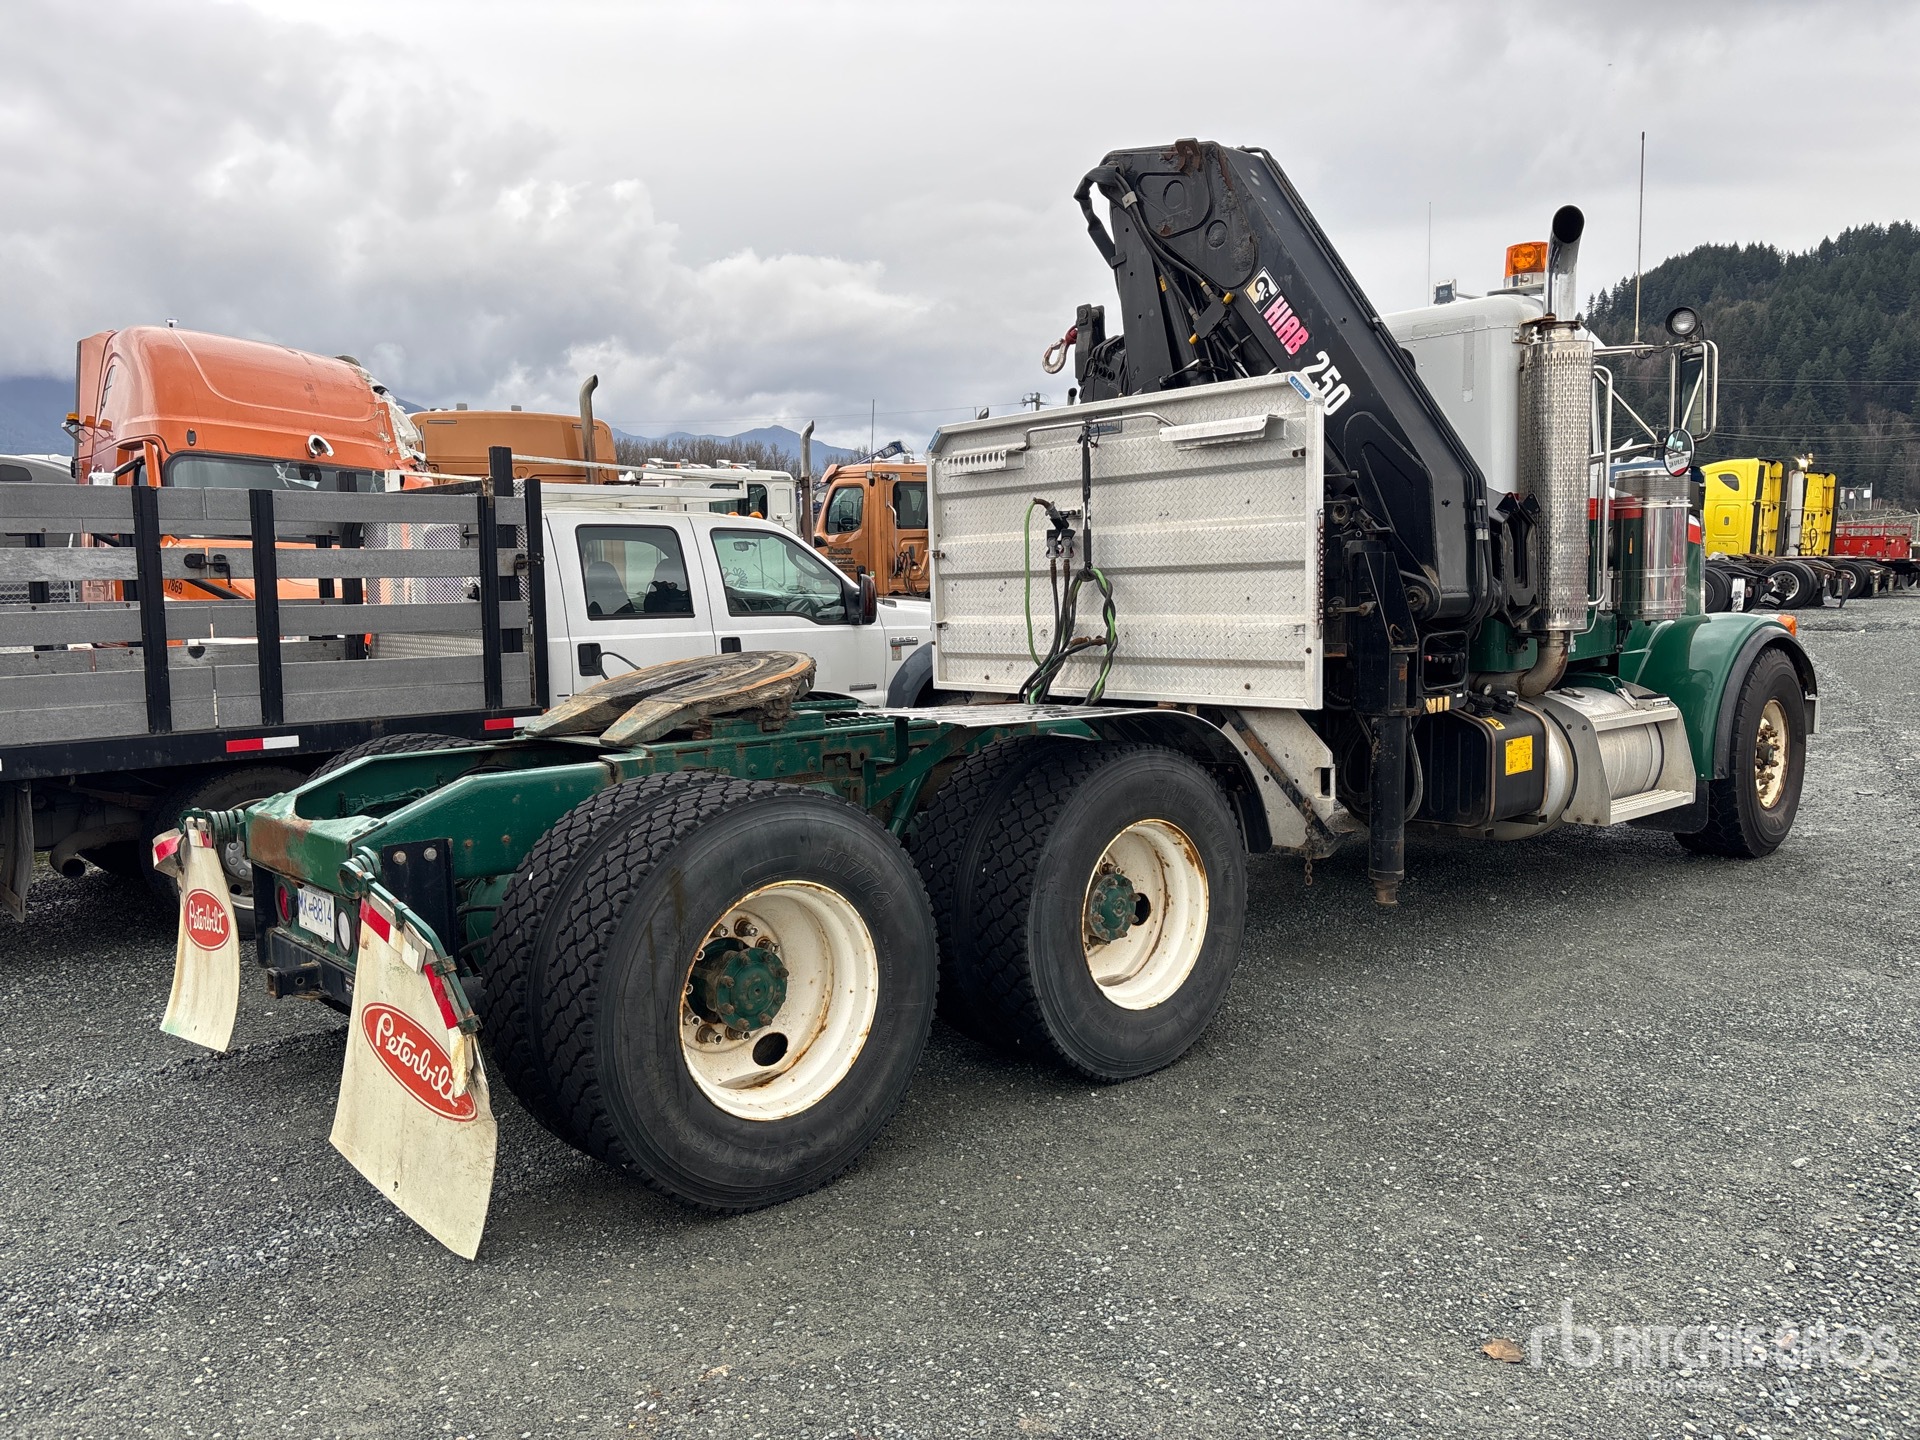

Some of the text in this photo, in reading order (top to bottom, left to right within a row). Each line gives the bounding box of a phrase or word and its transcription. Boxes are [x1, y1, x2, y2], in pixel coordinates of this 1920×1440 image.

[1263, 295, 1310, 355] HIAB
[1300, 350, 1351, 416] 250
[817, 847, 893, 911] M774
[189, 899, 225, 935] Peterbilt
[312, 896, 333, 929] 8814
[376, 1013, 459, 1107] Peterbilt
